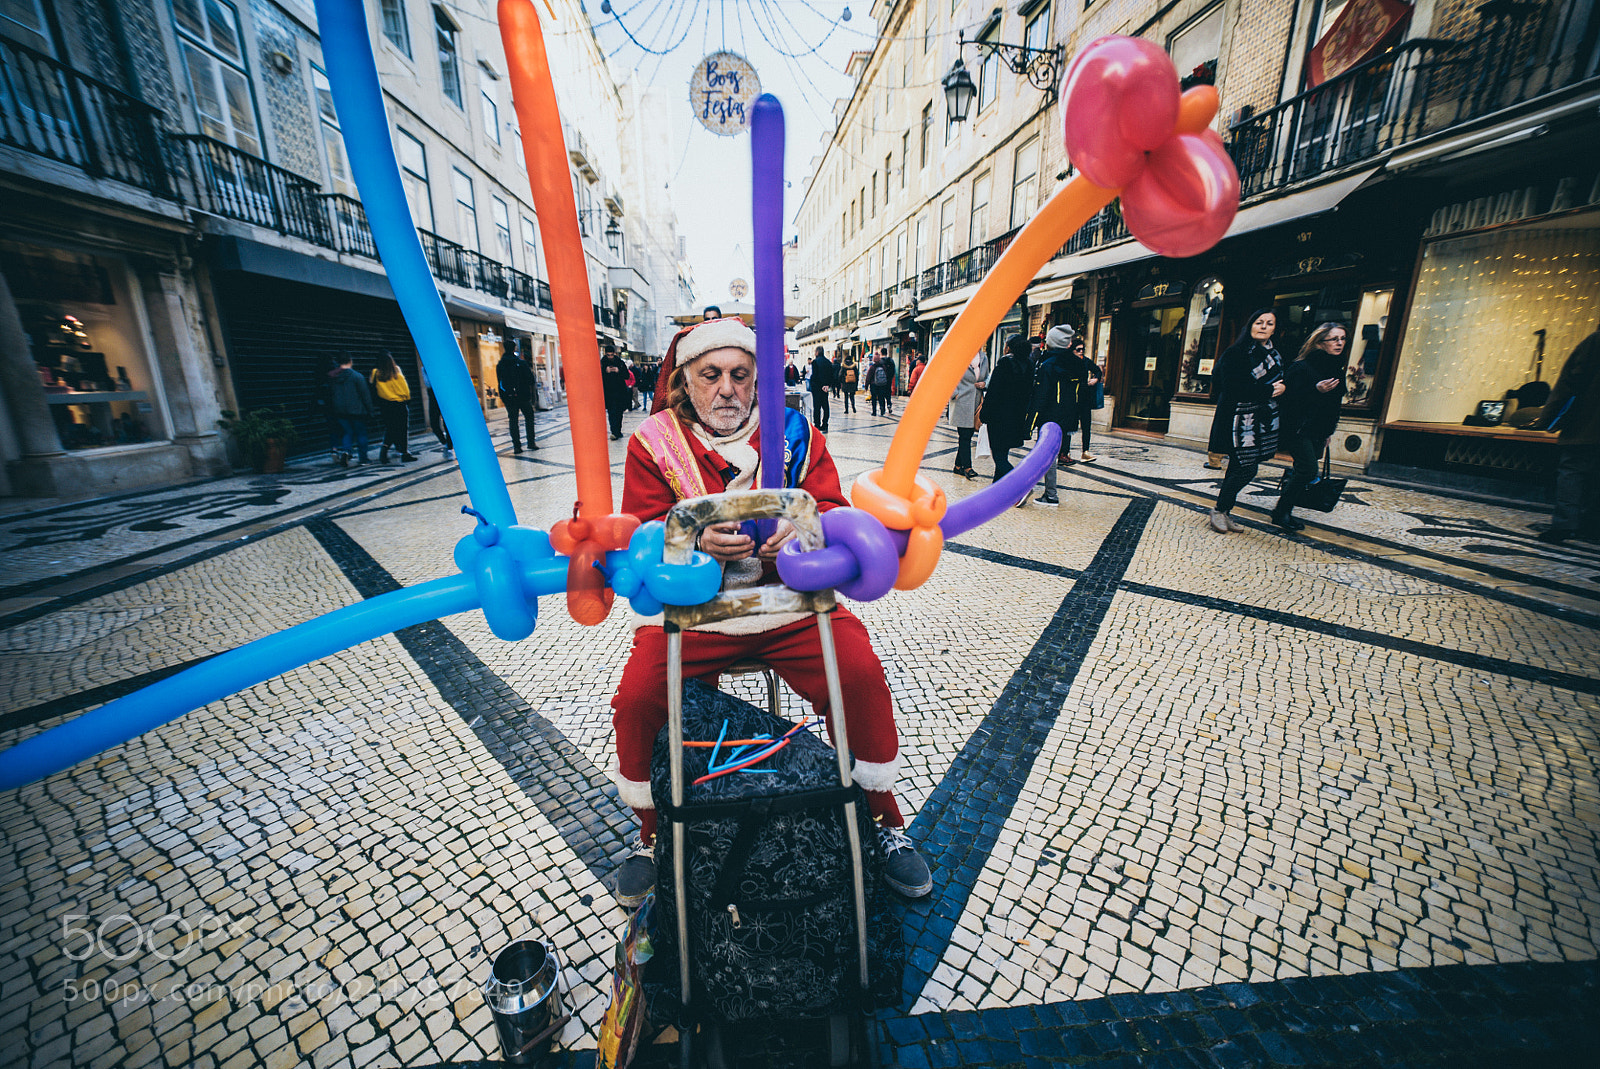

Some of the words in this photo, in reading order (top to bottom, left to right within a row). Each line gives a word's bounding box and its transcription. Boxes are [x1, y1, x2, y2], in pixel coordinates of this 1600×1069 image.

[706, 61, 743, 93] Boas
[702, 90, 750, 124] Festas
[1296, 231, 1313, 242] 197
